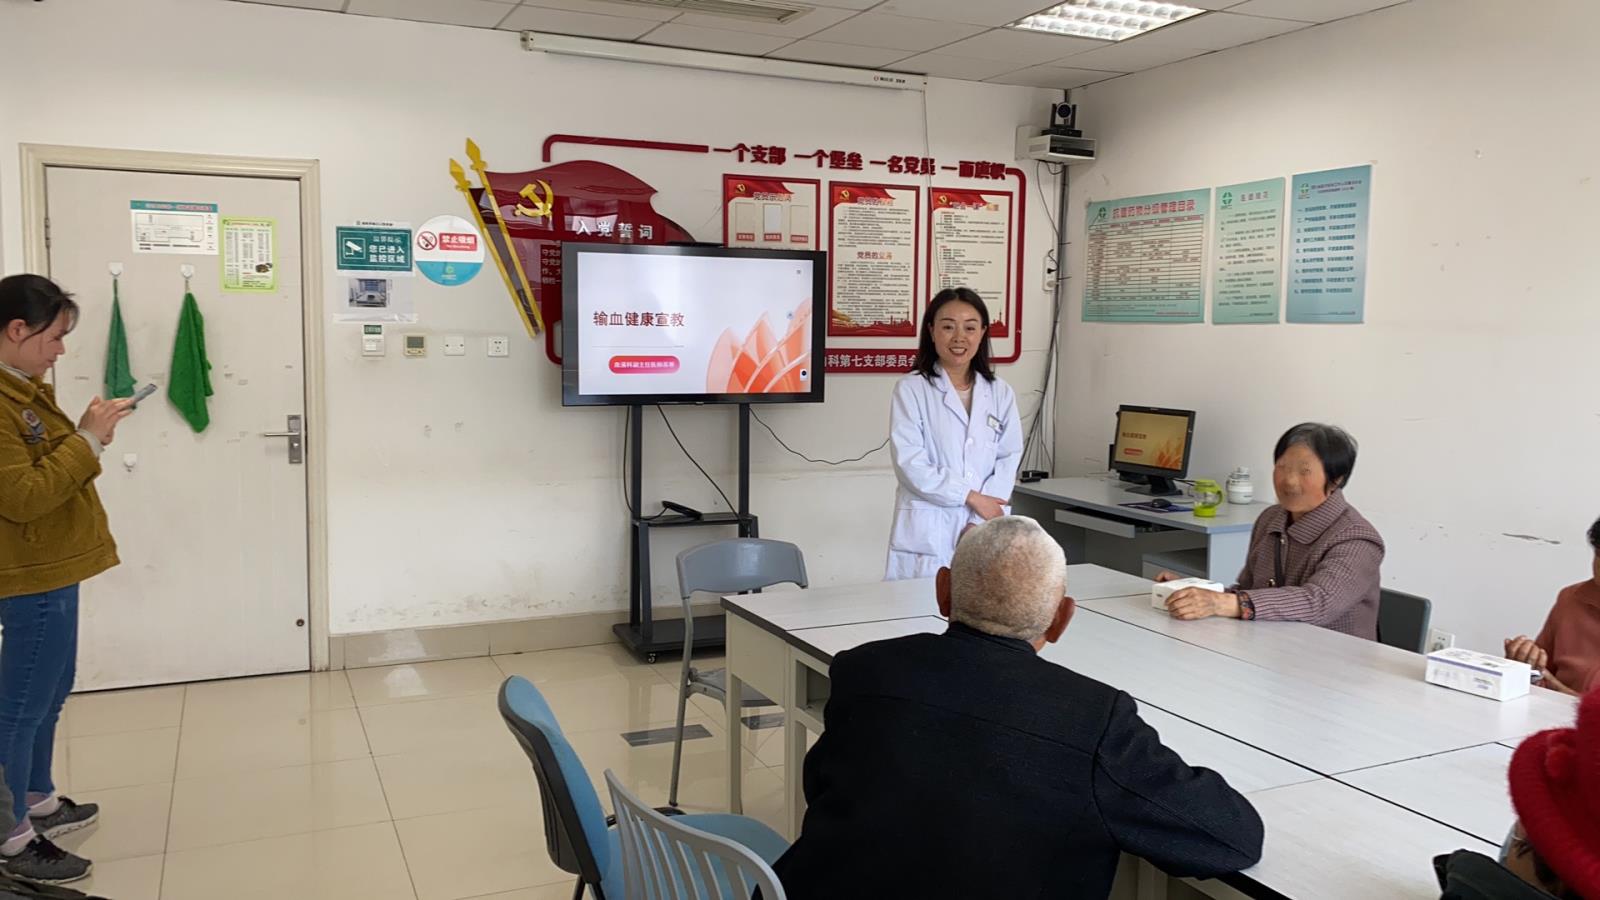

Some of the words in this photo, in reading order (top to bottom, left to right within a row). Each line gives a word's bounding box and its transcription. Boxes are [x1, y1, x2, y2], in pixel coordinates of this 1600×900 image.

[713, 143, 786, 165] 一个支部
[794, 149, 863, 171] 一个堡垒
[869, 155, 936, 176] 一名党员
[941, 160, 1006, 180] 一面旗帜
[577, 220, 653, 239] 入党誓词
[442, 234, 475, 244] 禁止吸烟
[369, 245, 405, 254] 您已进入
[369, 254, 405, 263] 监控区域
[593, 311, 685, 327] 输血健康宣教
[825, 354, 917, 367] 科第七支部委员会
